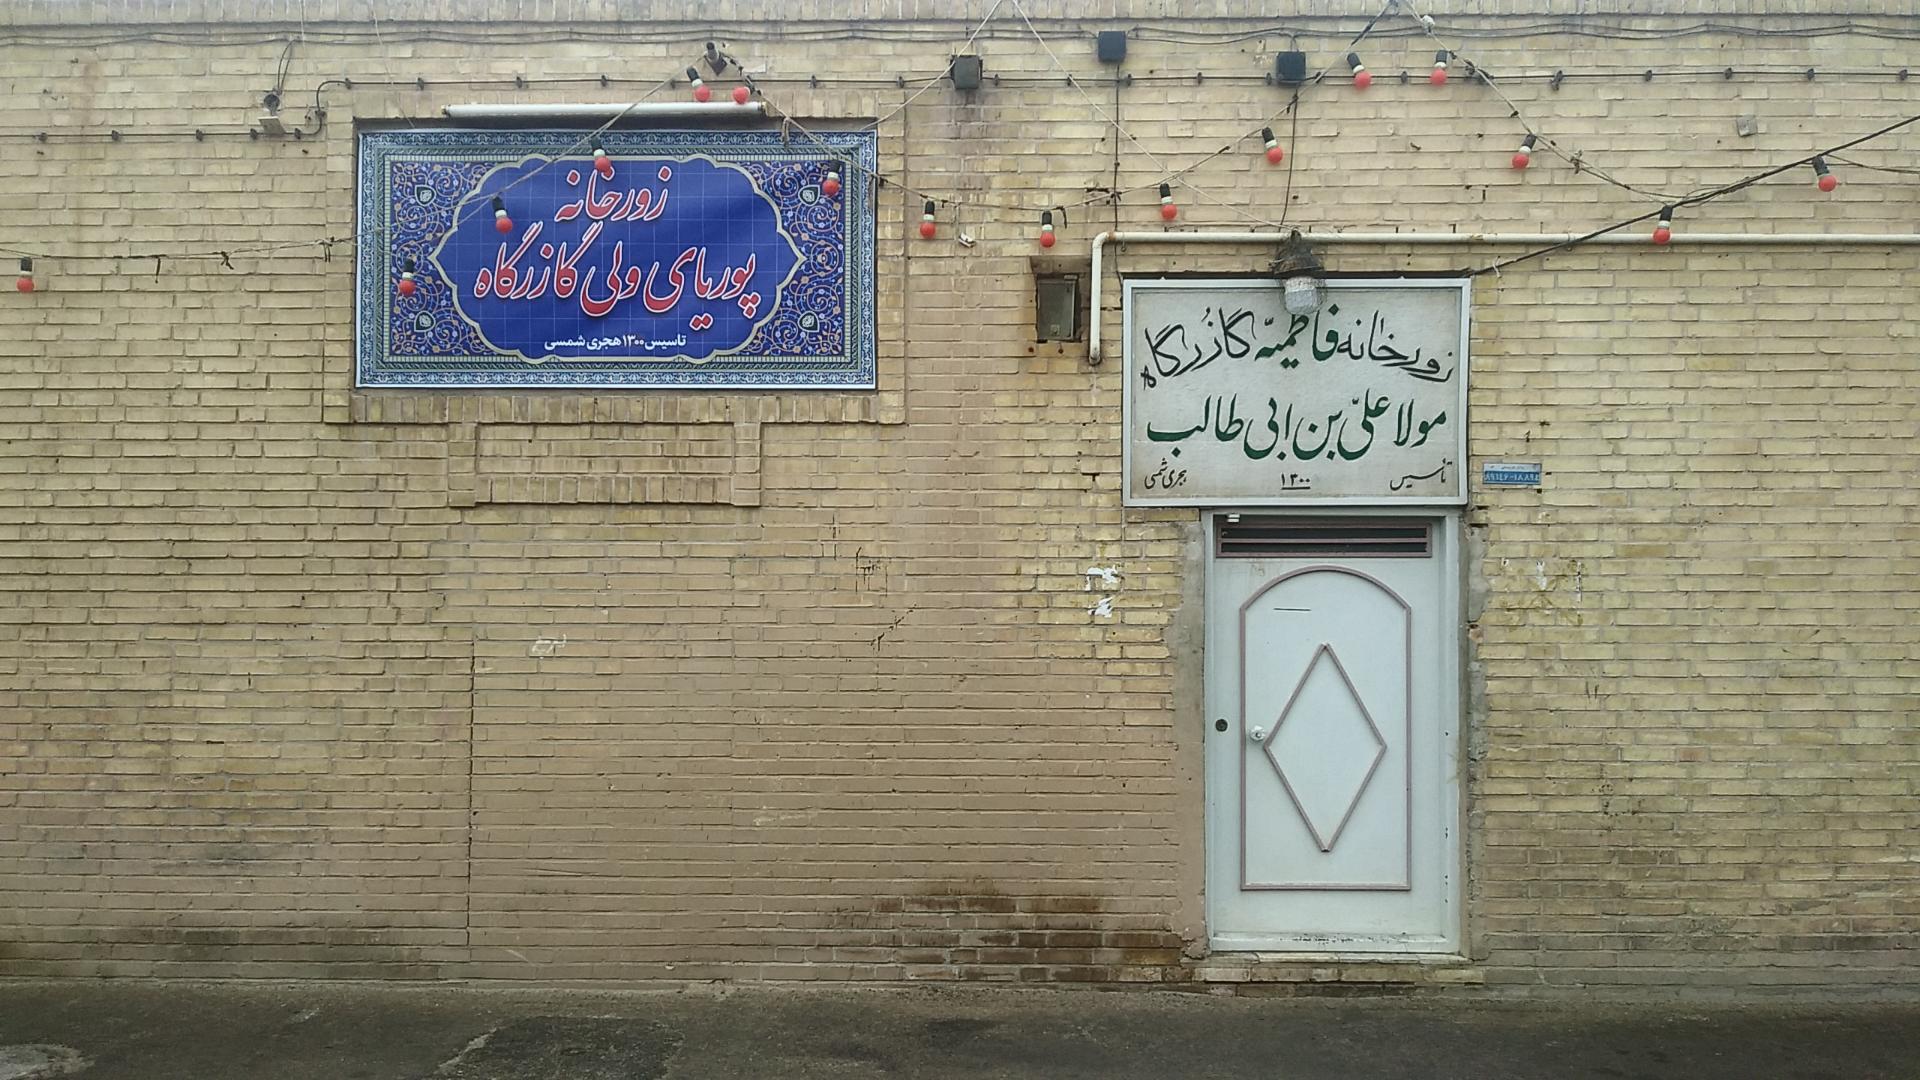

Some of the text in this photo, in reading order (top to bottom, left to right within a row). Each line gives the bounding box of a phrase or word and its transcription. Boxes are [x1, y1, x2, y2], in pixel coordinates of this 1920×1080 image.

[554, 166, 672, 221] زورخانه
[474, 221, 761, 330] پوریای ولی گازرگاه
[544, 334, 687, 351] تاسیس ۱۳۰۰ هجری شمسی
[1147, 393, 1244, 457] طالب
[1243, 397, 1293, 461] ابی
[1292, 410, 1343, 461] بن
[1393, 399, 1447, 448] مولا
[1144, 457, 1168, 489] شمسی
[1162, 469, 1187, 489] هجری
[1281, 473, 1311, 487] ۱۳۰۰
